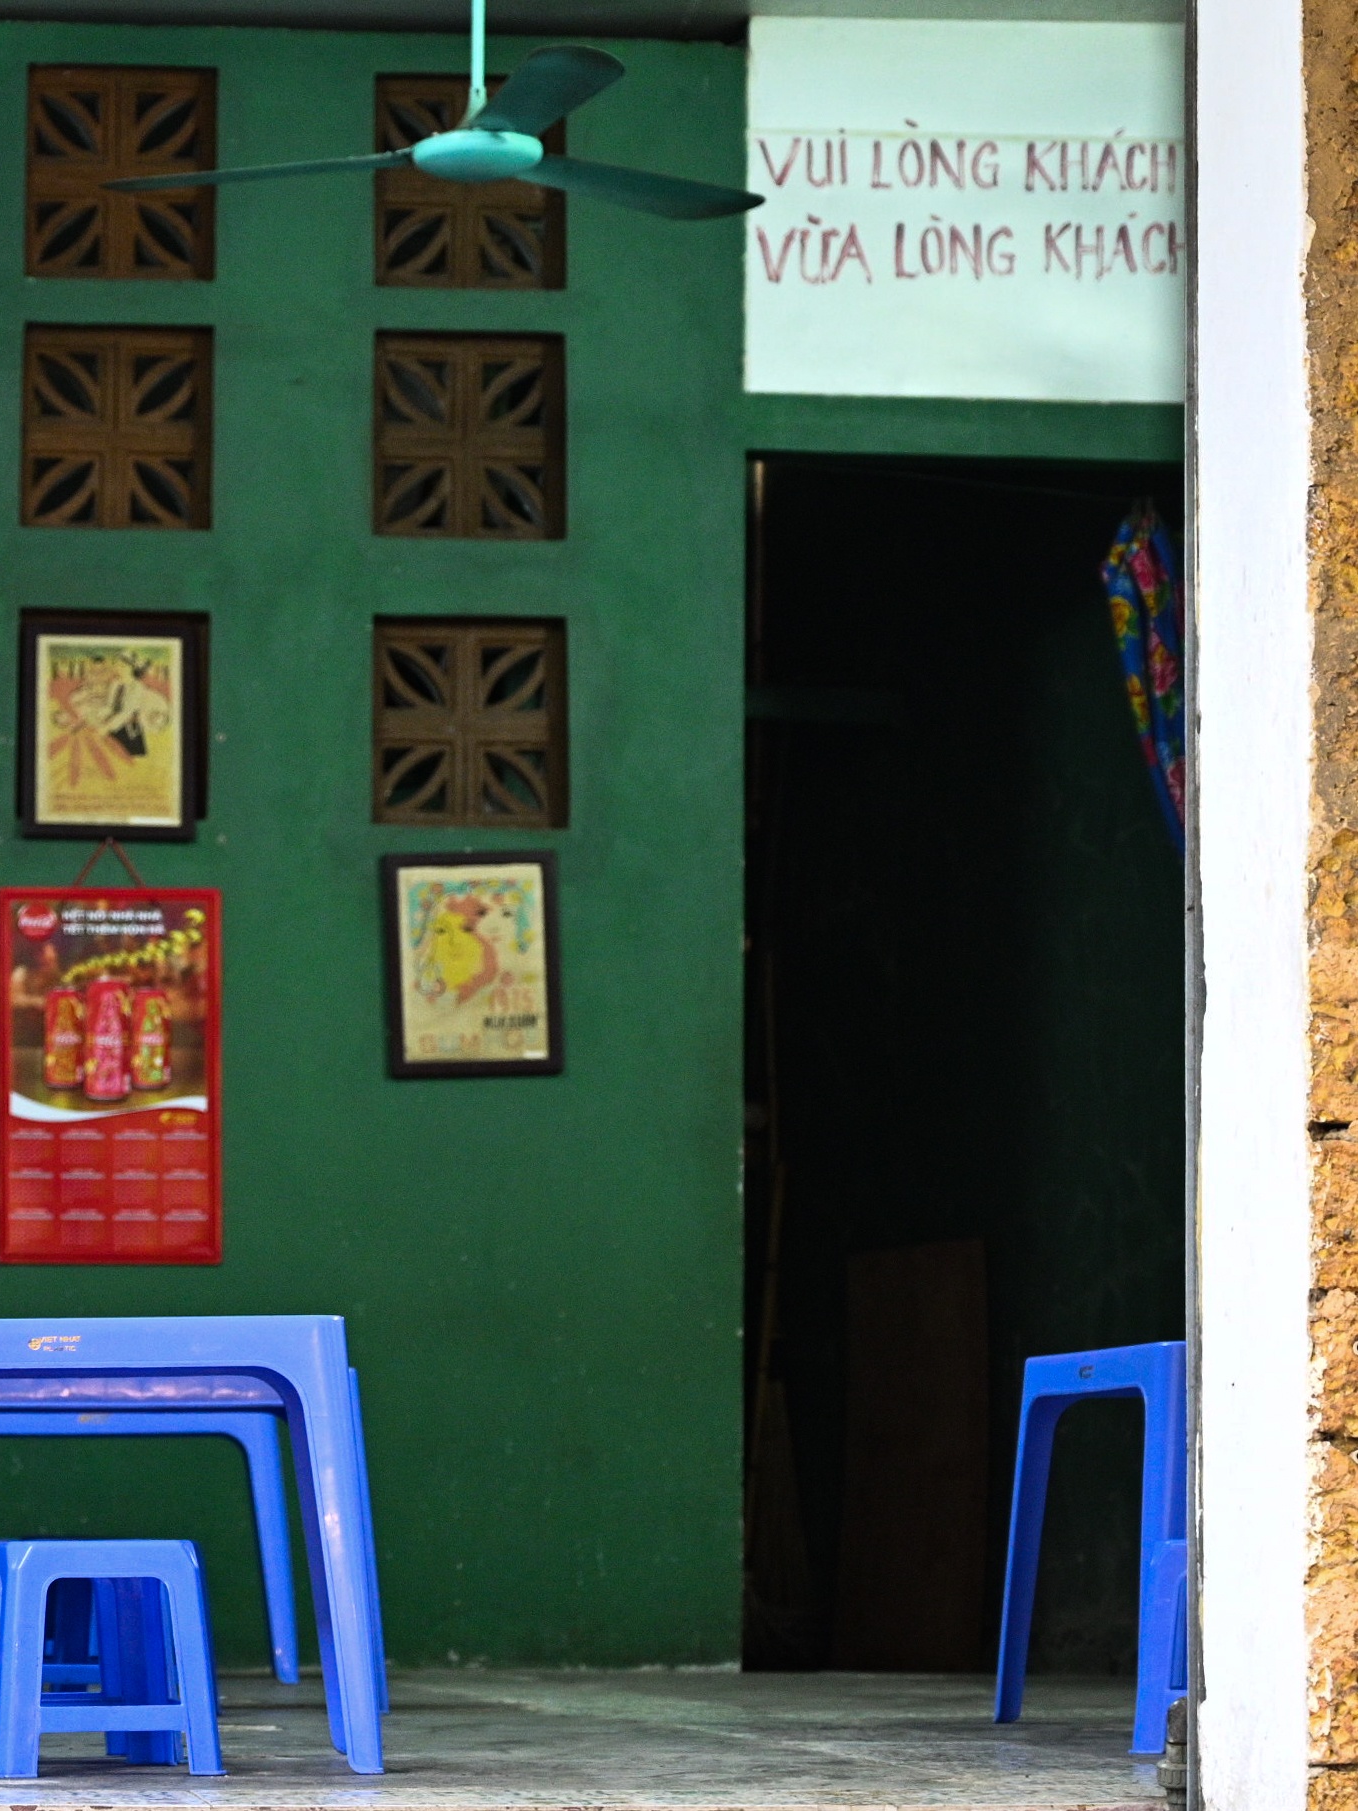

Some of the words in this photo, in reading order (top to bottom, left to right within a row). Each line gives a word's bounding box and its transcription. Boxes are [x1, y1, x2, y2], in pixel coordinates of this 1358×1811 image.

[870, 118, 1001, 191] LÒNG
[1024, 127, 1177, 194] KHÁCH
[756, 213, 873, 285] VỪA
[894, 213, 1017, 282] LÒNG
